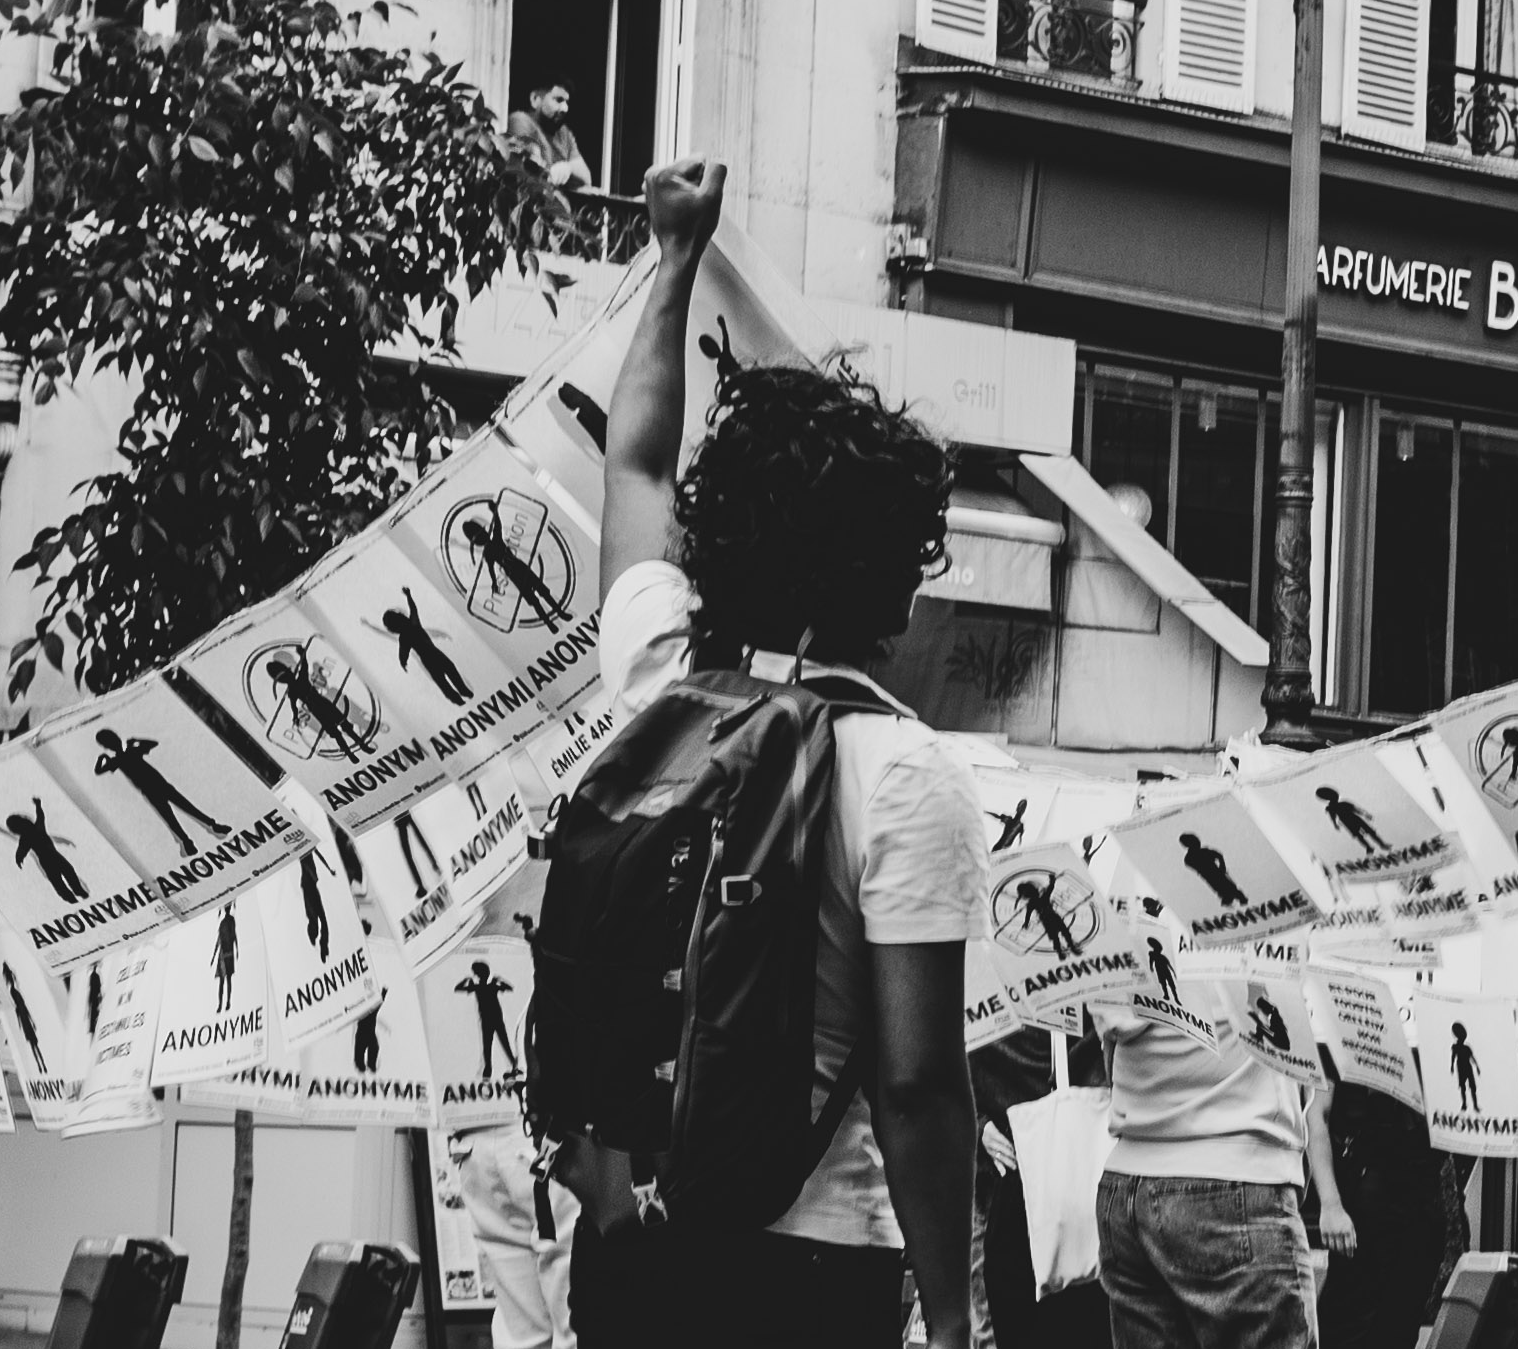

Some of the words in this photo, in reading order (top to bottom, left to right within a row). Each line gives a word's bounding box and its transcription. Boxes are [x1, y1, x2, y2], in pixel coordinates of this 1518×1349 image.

[1315, 244, 1470, 310] ARFUMERIE
[528, 608, 602, 692] ANONY
[323, 737, 428, 812] ANONYM
[552, 736, 592, 780] ÉMILIE
[588, 708, 615, 747] 4AN
[157, 809, 293, 898] ANONYME
[449, 793, 524, 878] ANONYME
[1191, 889, 1310, 937] ANONYME
[284, 948, 369, 1019] ANONYME
[1025, 952, 1139, 997] ANONYME
[162, 1007, 264, 1053] ANONYME
[1133, 992, 1215, 1038] ANONYME
[308, 1079, 428, 1102] ANONYME
